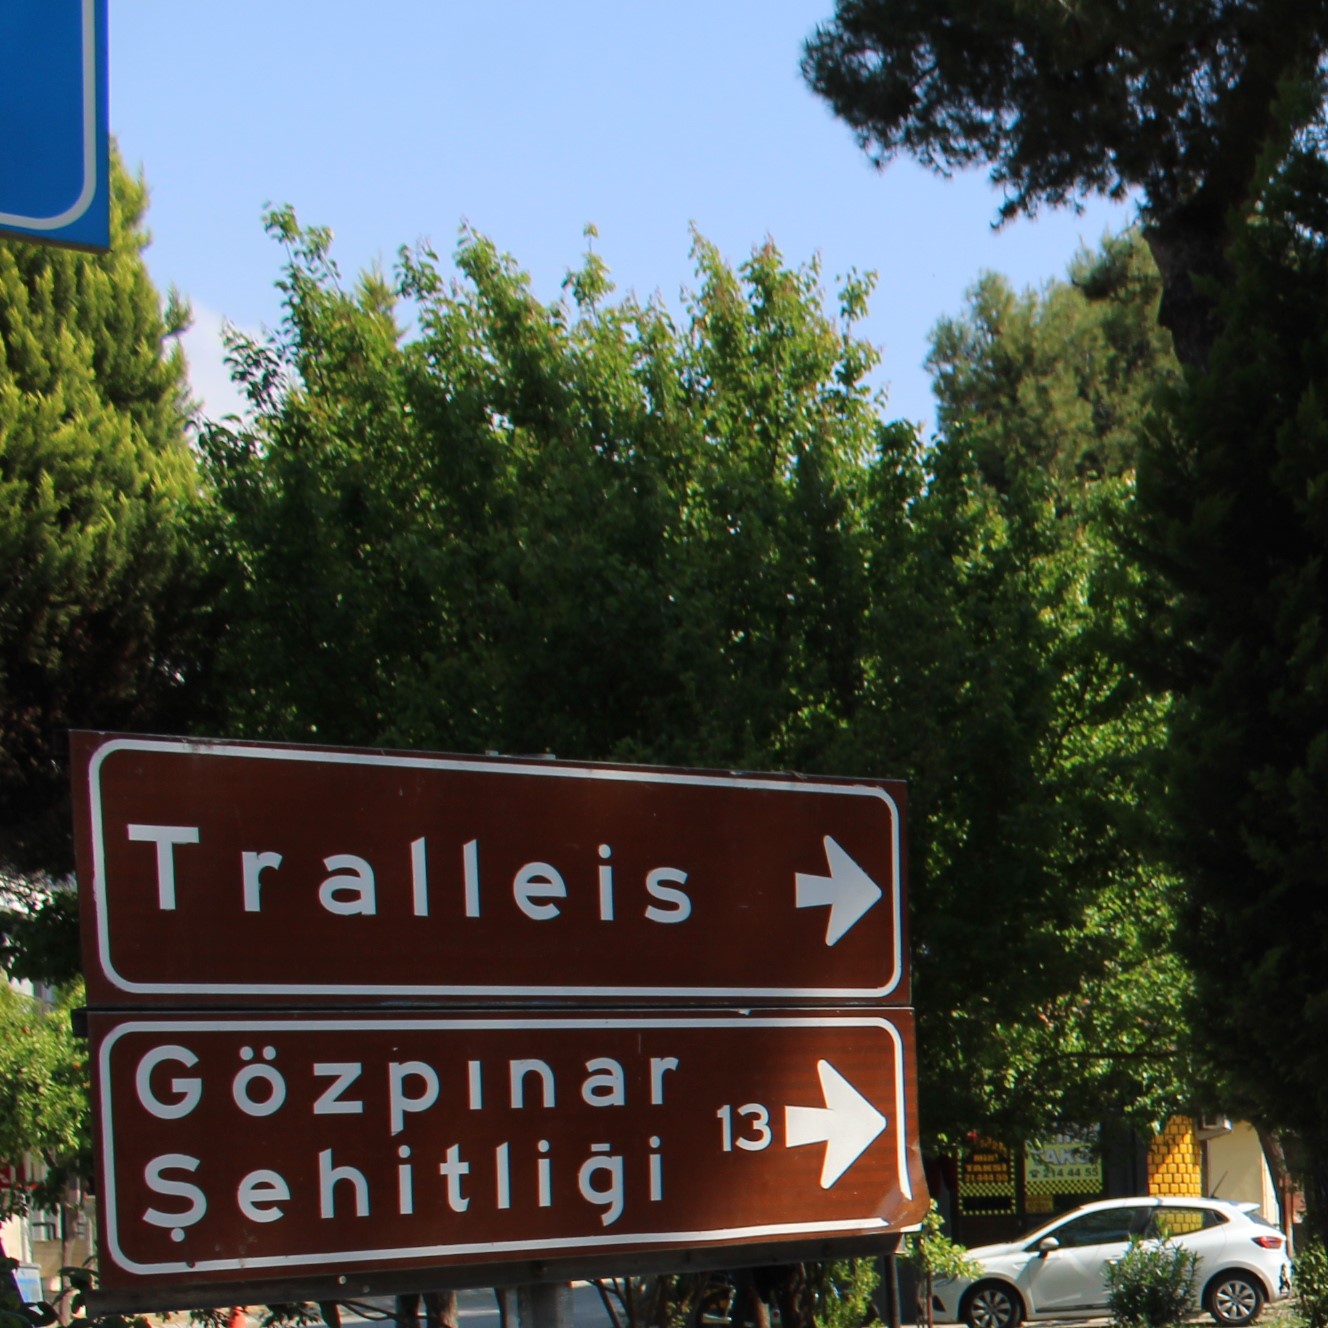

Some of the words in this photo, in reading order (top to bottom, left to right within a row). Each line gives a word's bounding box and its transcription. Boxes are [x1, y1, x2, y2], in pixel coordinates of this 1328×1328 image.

[127, 824, 692, 924] Tralleis
[135, 1045, 679, 1136] Gözpınar
[716, 1103, 773, 1152] 13
[143, 1136, 664, 1242] Şehitliği
